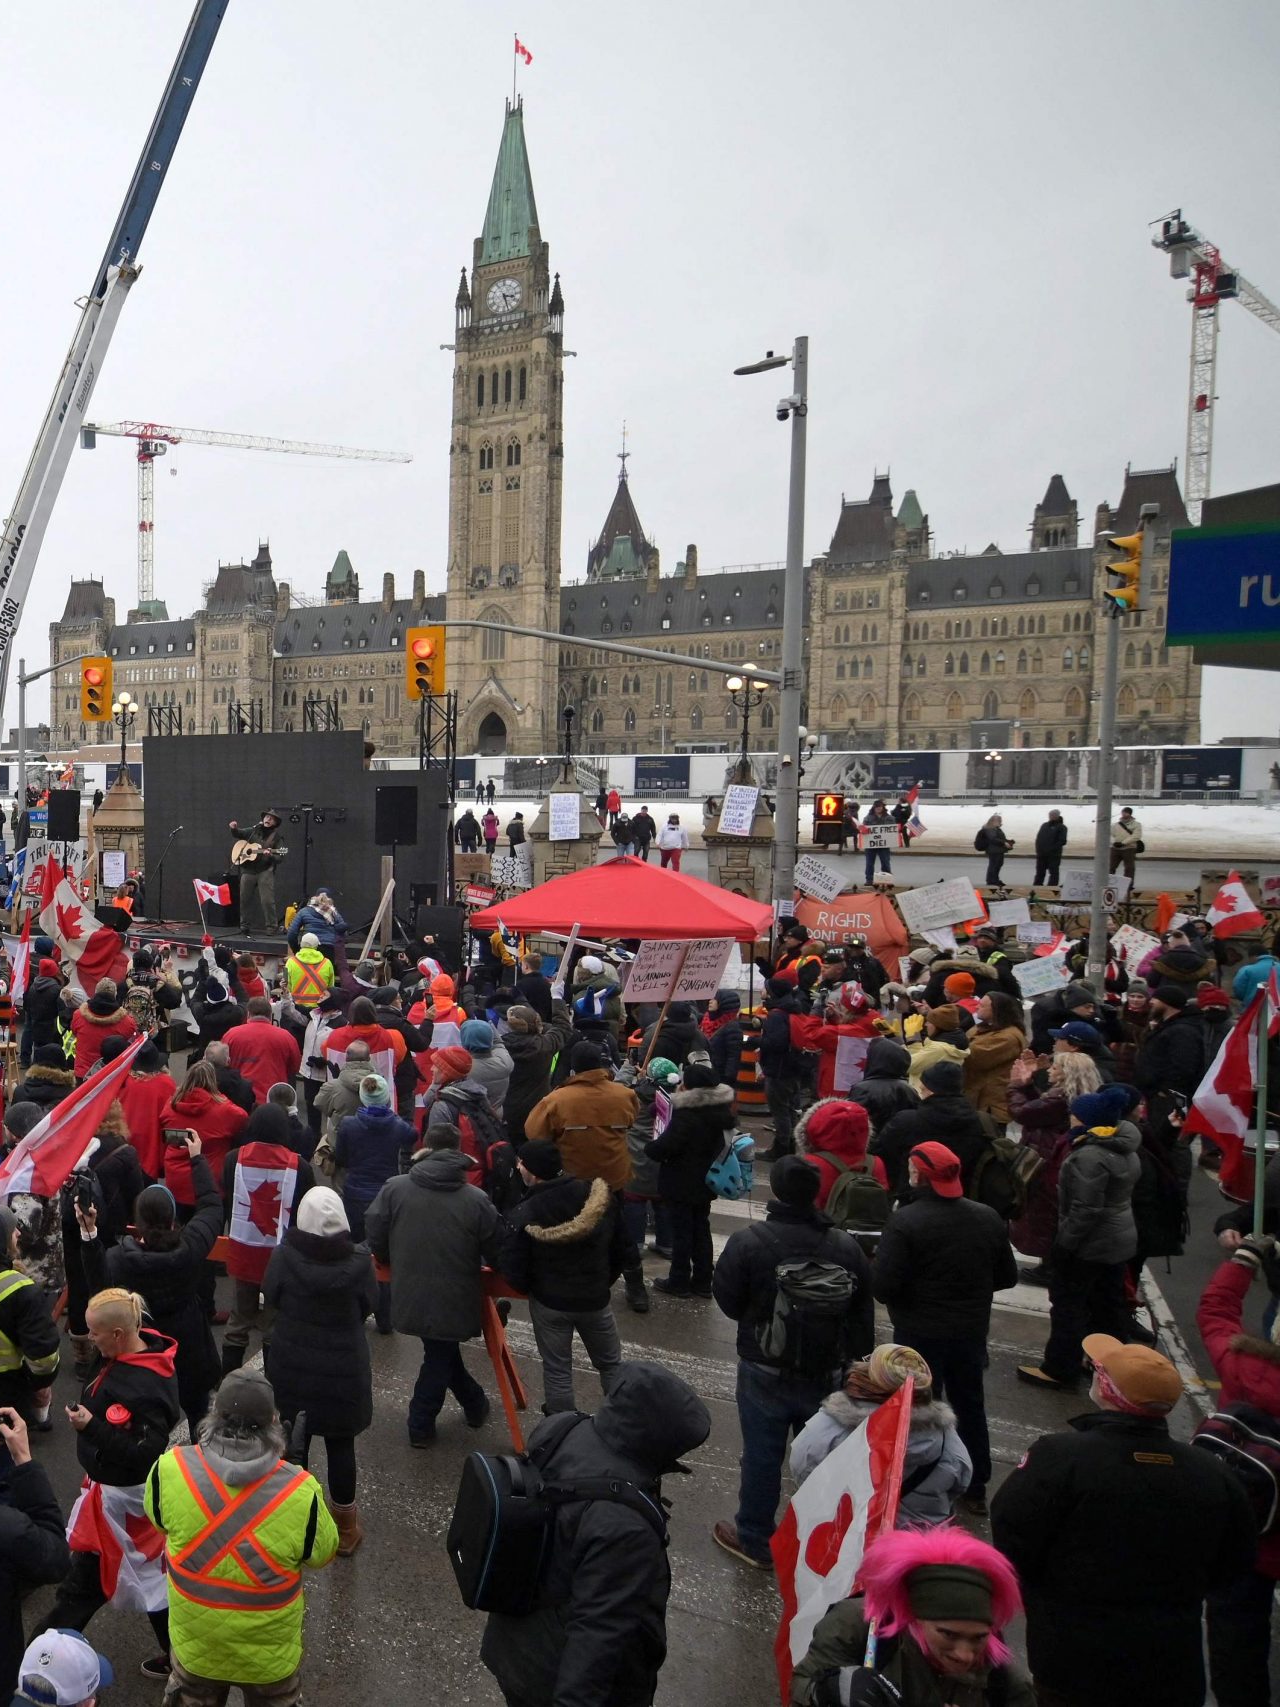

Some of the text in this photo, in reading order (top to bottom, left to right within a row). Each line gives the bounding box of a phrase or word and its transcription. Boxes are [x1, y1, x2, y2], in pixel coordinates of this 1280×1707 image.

[880, 826, 898, 834] FREE
[30, 842, 80, 864] TRUCK OFF
[805, 856, 827, 872] MASKS
[794, 867, 834, 893] ISOLATION
[799, 861, 838, 887] MANDATES
[817, 911, 872, 929] RIGHTS
[806, 928, 838, 942] DONT
[842, 932, 868, 943] END
[643, 942, 682, 953] SAINTS
[632, 972, 672, 983] WARNING
[632, 983, 659, 992] BELL
[677, 979, 717, 992] RINGING
